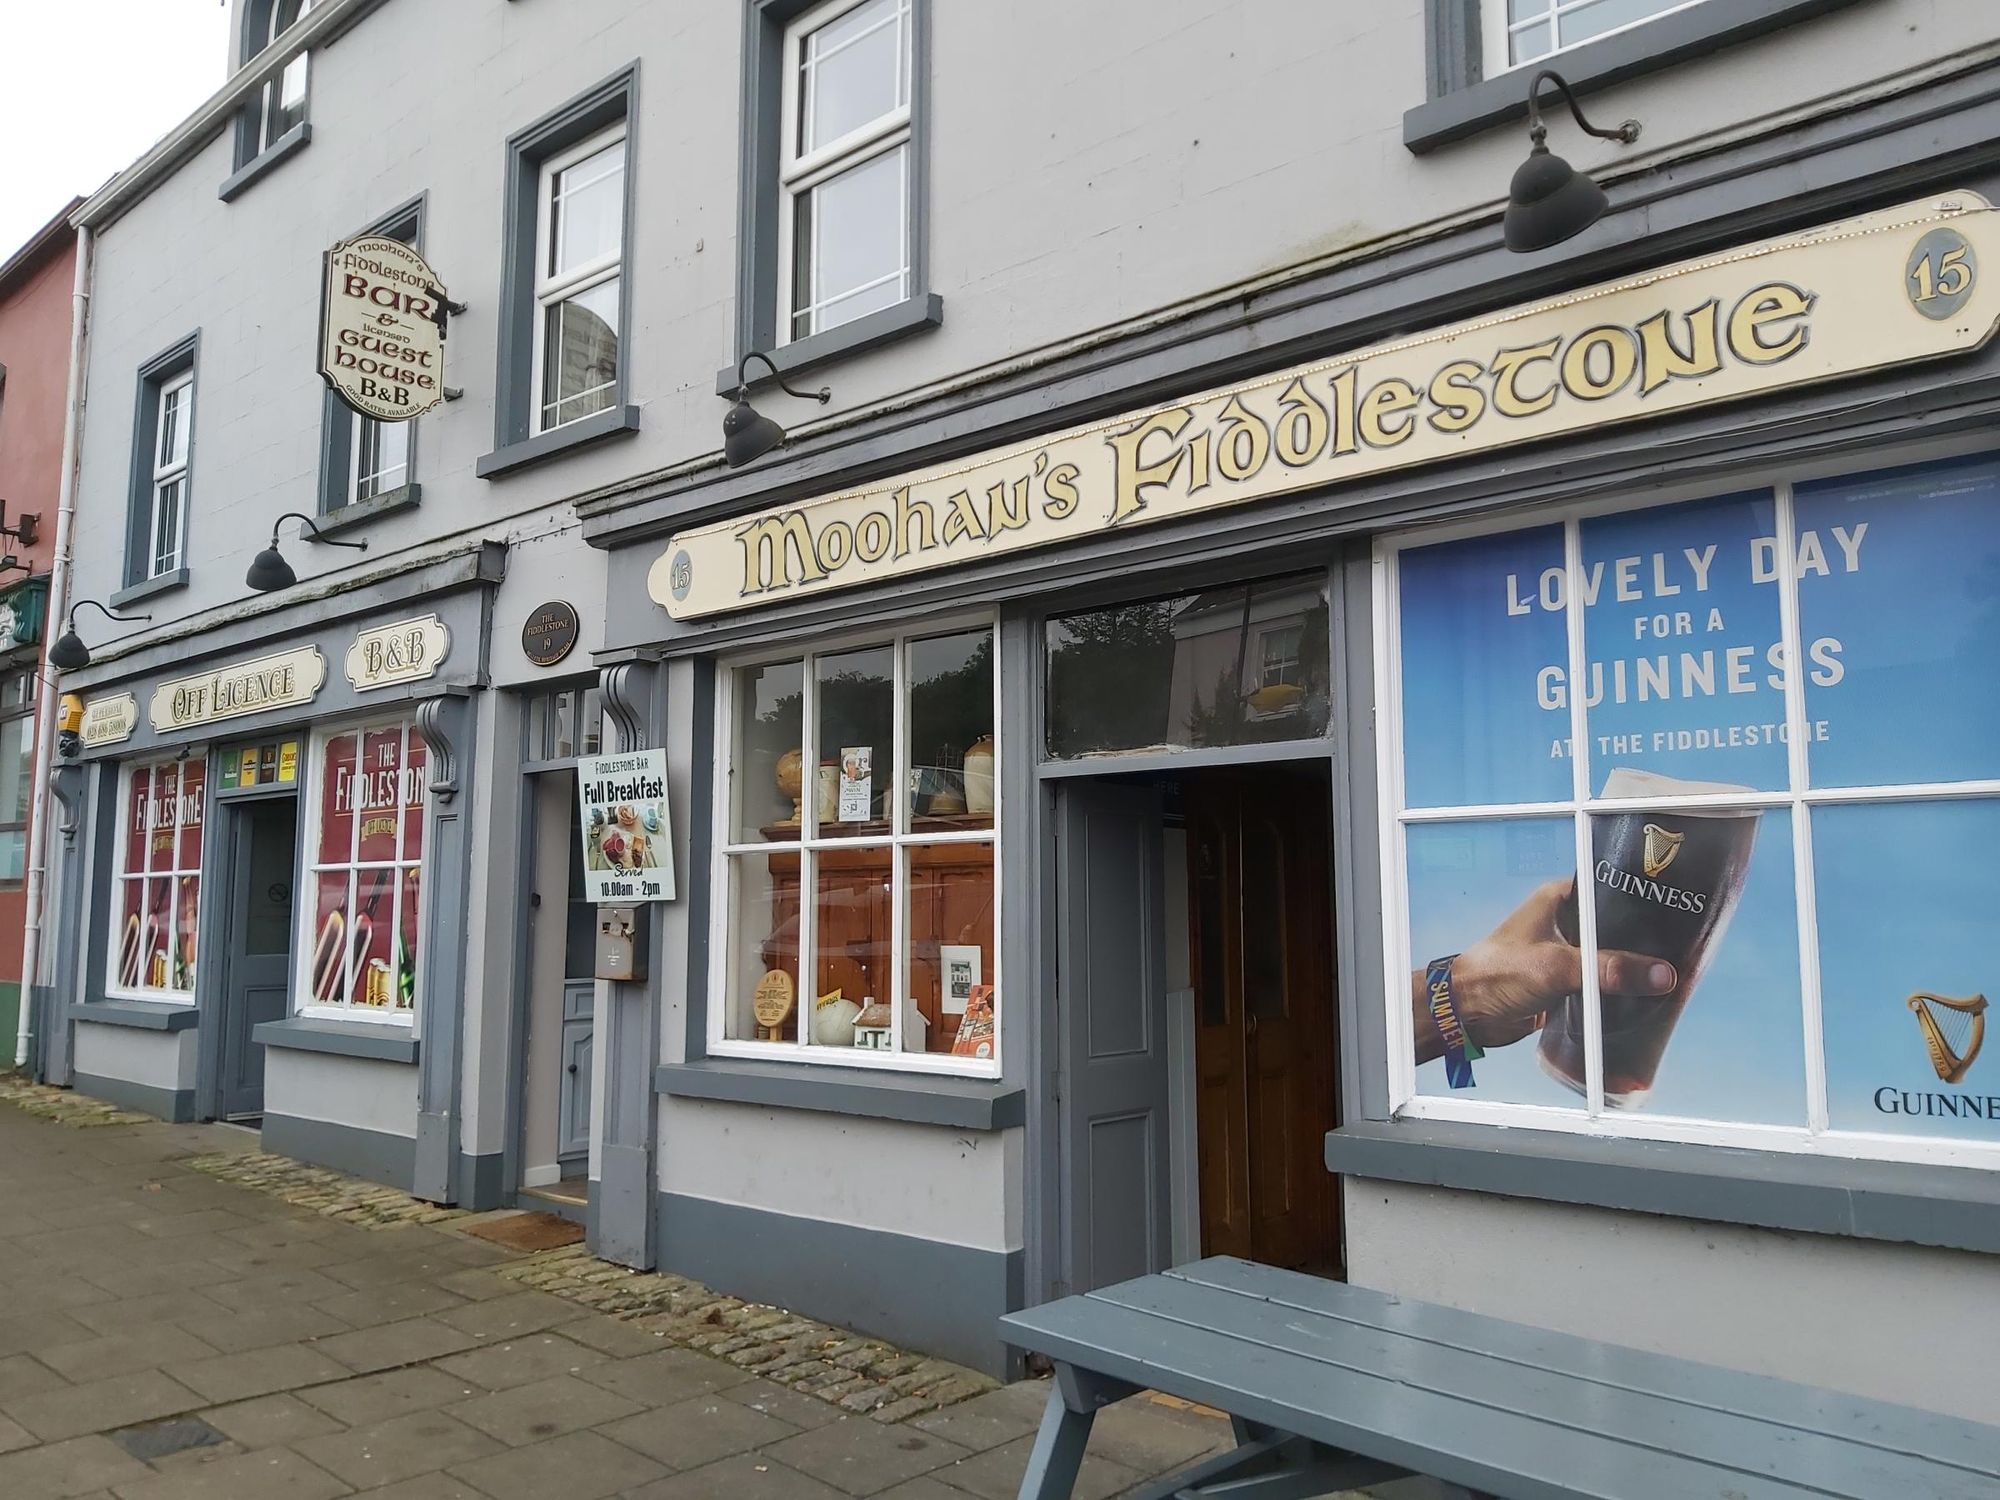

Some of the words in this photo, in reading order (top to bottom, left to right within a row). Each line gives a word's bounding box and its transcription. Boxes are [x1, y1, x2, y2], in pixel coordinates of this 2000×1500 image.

[1911, 244, 1972, 302] 15
[376, 313, 399, 326] &
[360, 377, 409, 406] B&B
[364, 399, 386, 414] RATES
[387, 402, 421, 416] AVAILABLE
[735, 451, 1082, 598] Moohan's
[1104, 283, 1818, 527] Fiddlestone
[671, 560, 691, 590] 15
[1507, 544, 1717, 616] LOVELY
[1750, 522, 1868, 584] DAY
[527, 619, 569, 636] FIDDLESTONE
[542, 614, 554, 624] THE
[1634, 611, 1692, 640] FOR
[1707, 607, 1725, 632] A
[365, 629, 425, 680] B&B
[1537, 636, 1845, 710] GUINNESS
[171, 685, 208, 722] OFF
[211, 664, 294, 716] LICENCE
[1598, 733, 1643, 756] THE
[1653, 720, 1830, 752] FIDDLESTOE
[379, 742, 396, 767] THE
[595, 759, 636, 775] FIDDLESTONE
[636, 756, 649, 770] BAR
[164, 774, 176, 795] THE
[584, 780, 605, 804] Full
[607, 775, 664, 801] Breakfast
[615, 862, 643, 877] Served
[601, 881, 633, 897] 10.00am
[642, 880, 660, 897] 2pm
[1596, 860, 1706, 914] GUINNESS
[1431, 981, 1465, 1049] SUMMER
